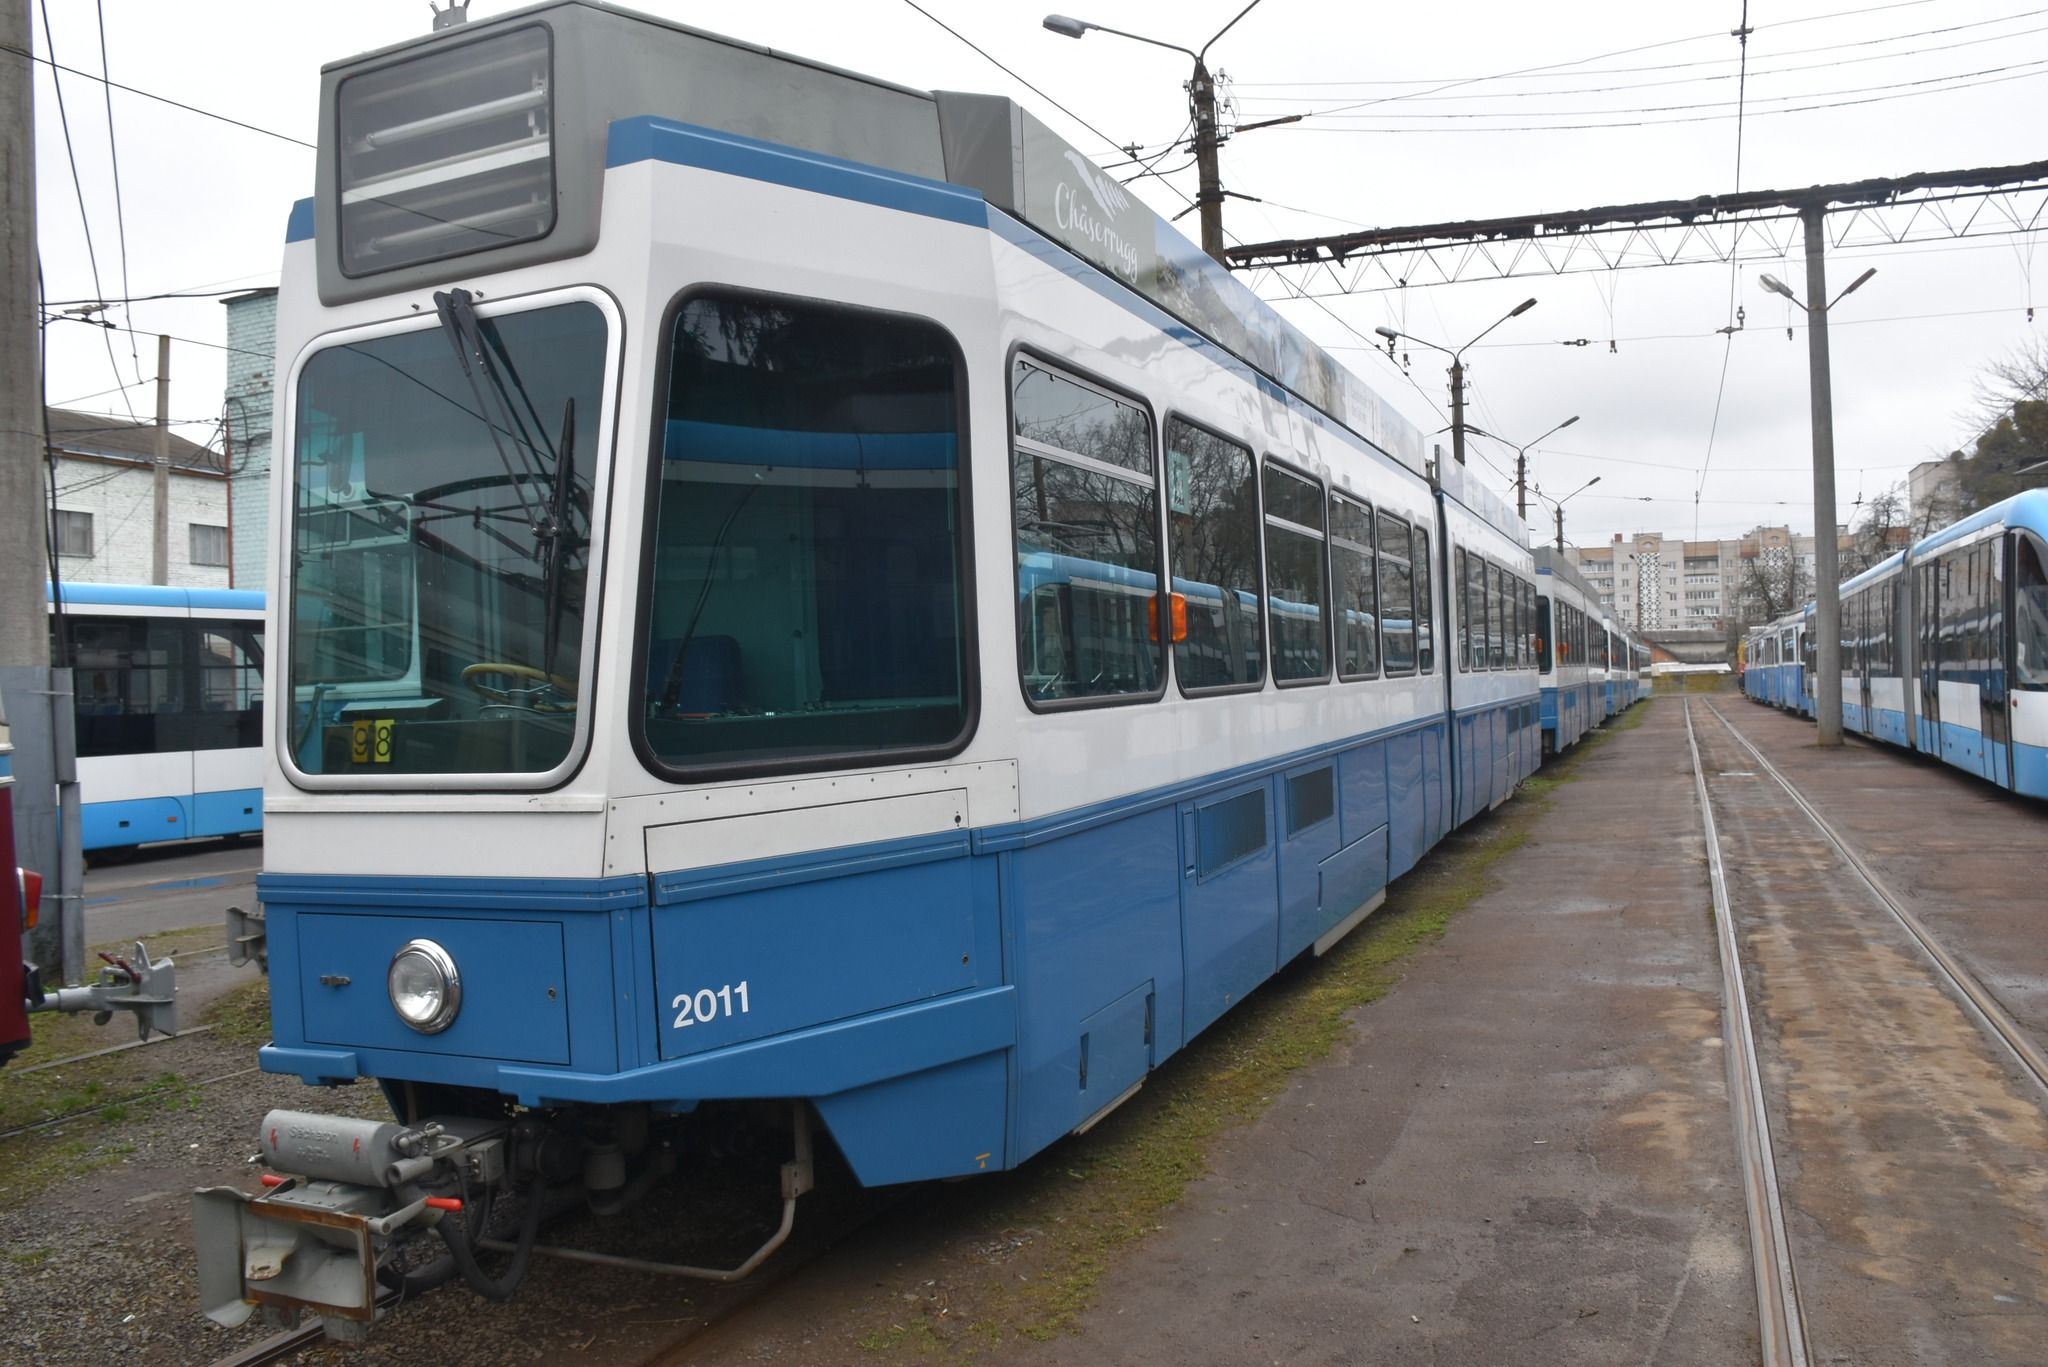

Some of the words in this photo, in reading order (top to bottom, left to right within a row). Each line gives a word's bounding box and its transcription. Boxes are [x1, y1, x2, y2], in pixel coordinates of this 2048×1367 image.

[1055, 182, 1138, 283] Chäserrugg
[354, 726, 391, 757] 98
[672, 981, 749, 1029] 2011
